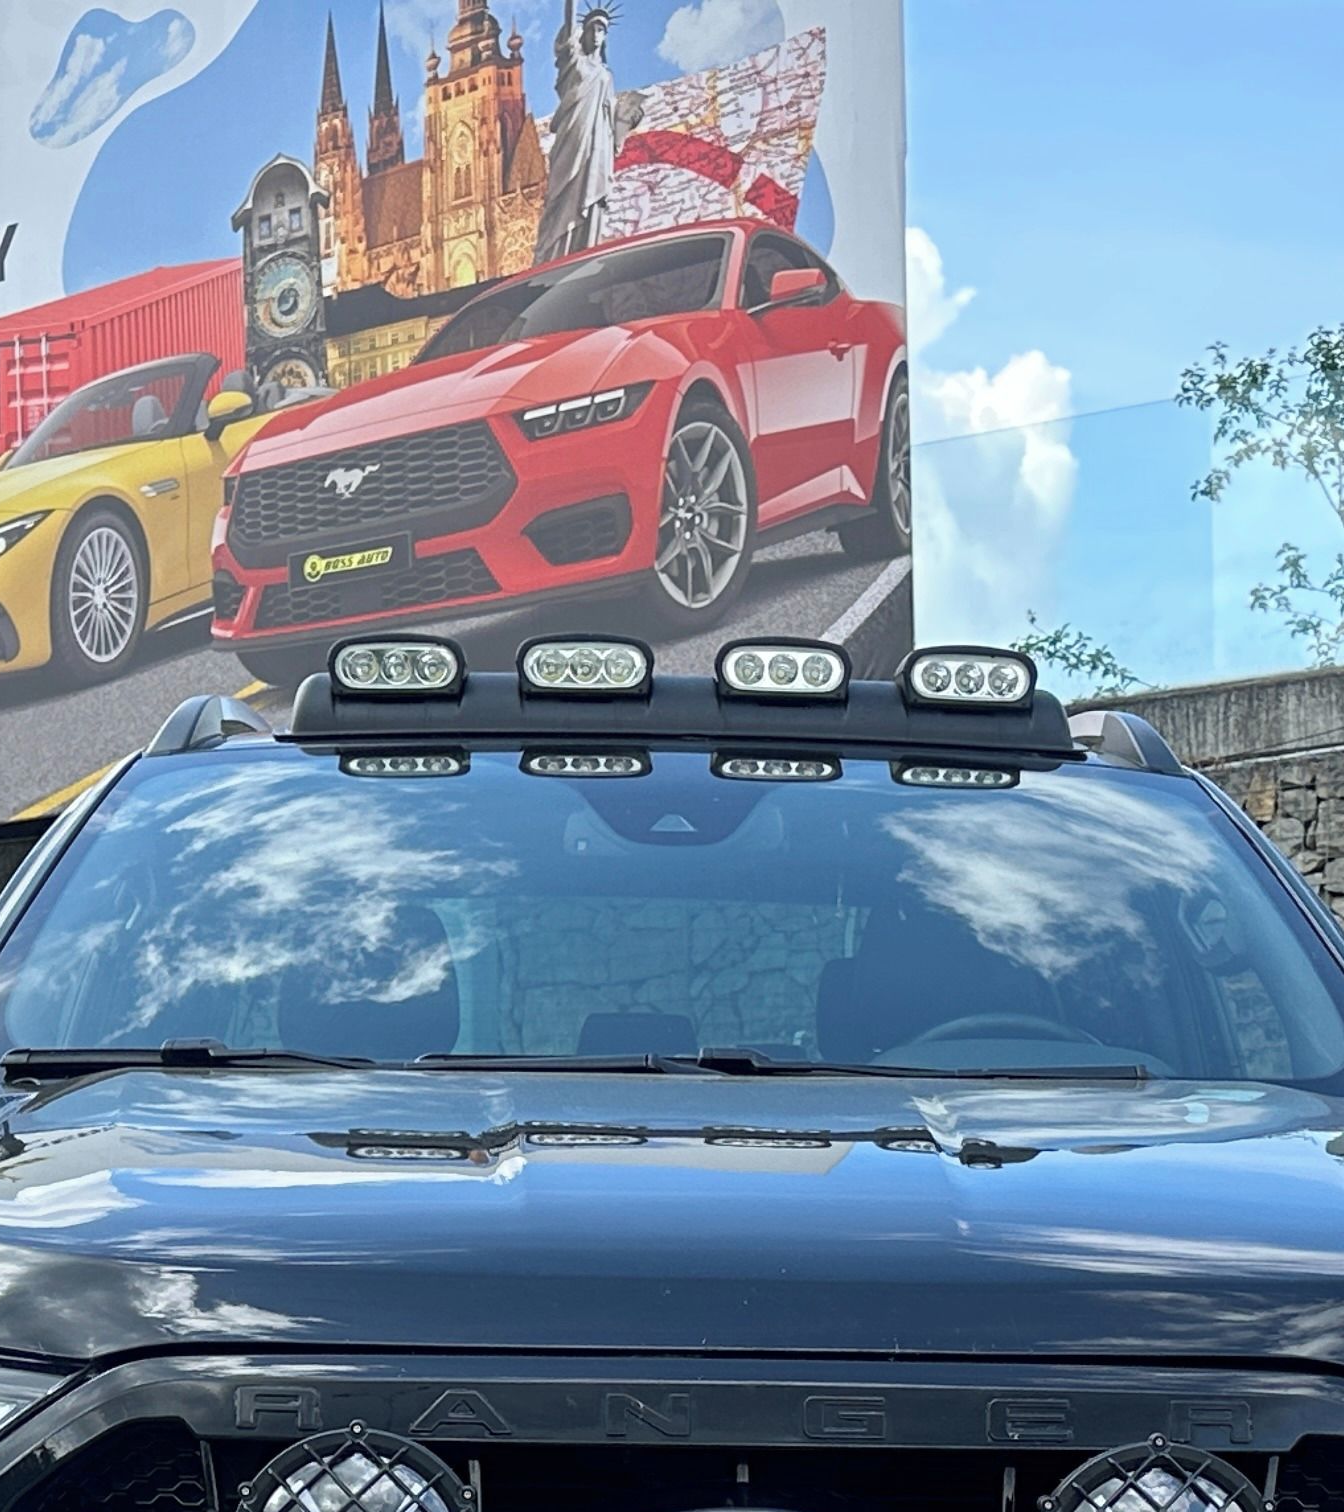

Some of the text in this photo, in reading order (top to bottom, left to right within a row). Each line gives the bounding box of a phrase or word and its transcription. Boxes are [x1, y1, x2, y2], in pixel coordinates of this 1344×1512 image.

[324, 550, 389, 571] BOSS AUTO
[236, 1383, 1251, 1441] RANGER
